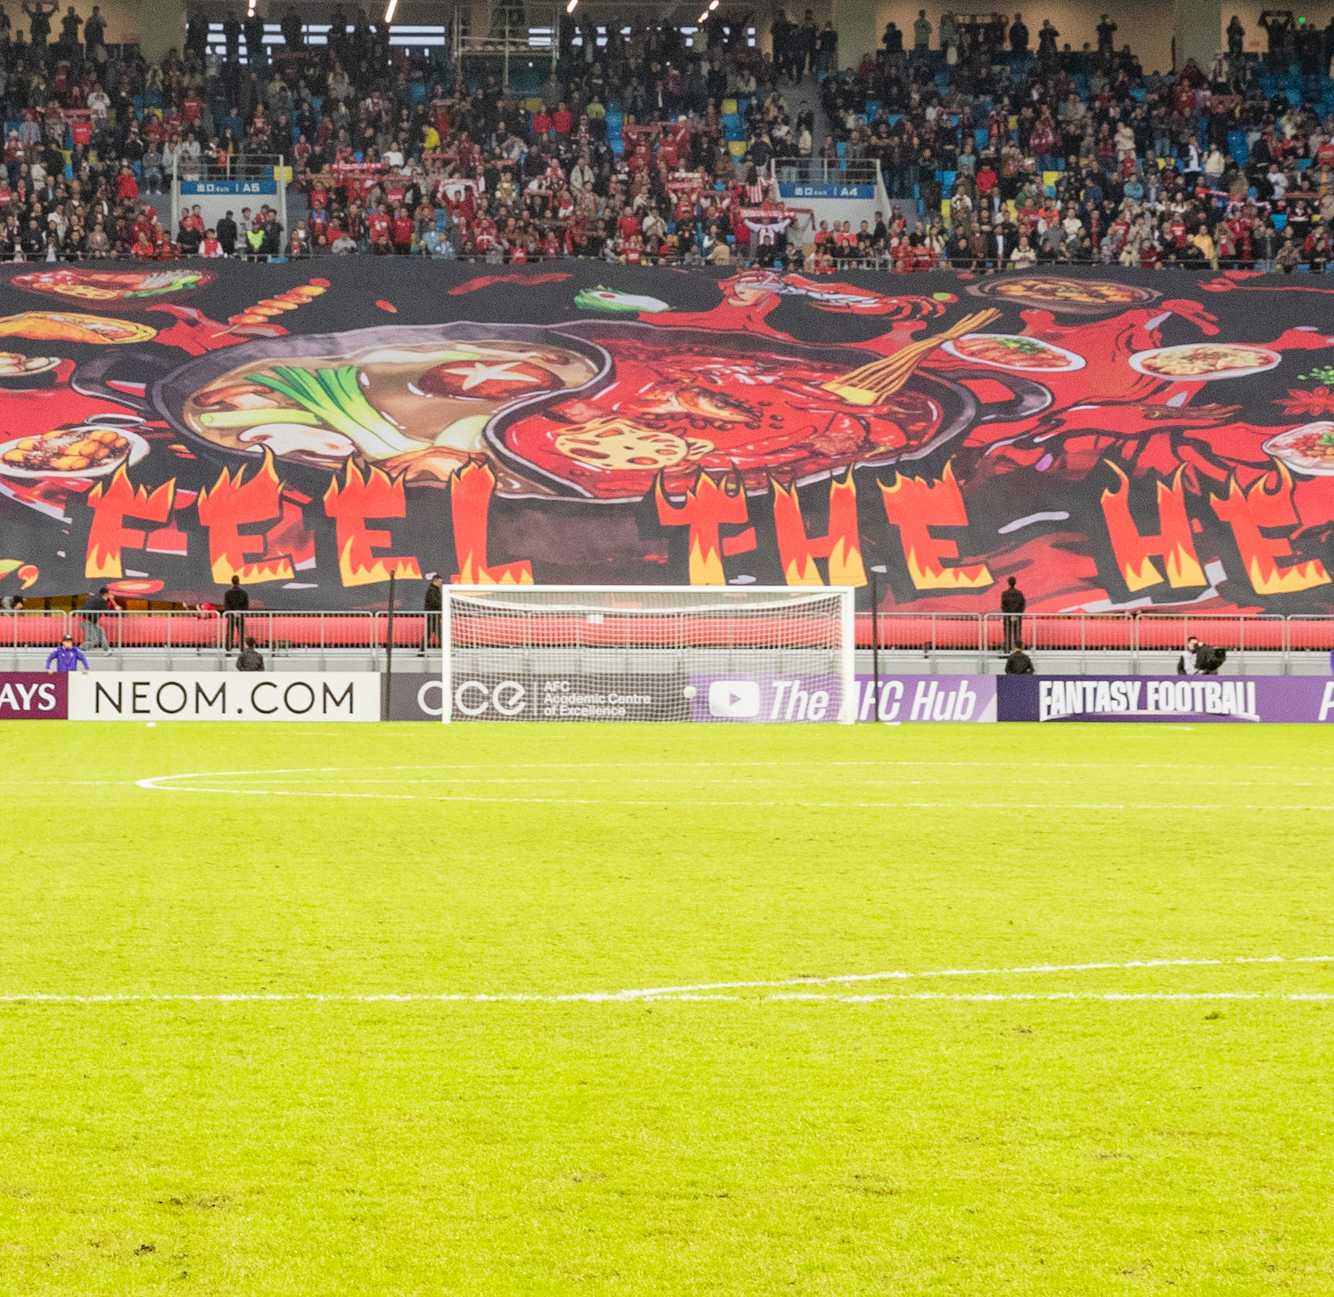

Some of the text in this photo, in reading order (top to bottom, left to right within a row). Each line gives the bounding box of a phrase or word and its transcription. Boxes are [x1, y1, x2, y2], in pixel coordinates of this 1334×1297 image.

[243, 183, 260, 192] A5
[840, 187, 858, 196] A4
[85, 445, 535, 587] FEEL
[655, 460, 994, 590] THE
[544, 681, 571, 692] AFC
[94, 681, 355, 715] NEOM.COM
[544, 693, 651, 705] Academic Centre
[769, 680, 829, 720] The
[910, 680, 977, 721] Hub
[1039, 680, 1259, 721] FANTASY FOOTBALL
[544, 705, 626, 716] of Excellence
